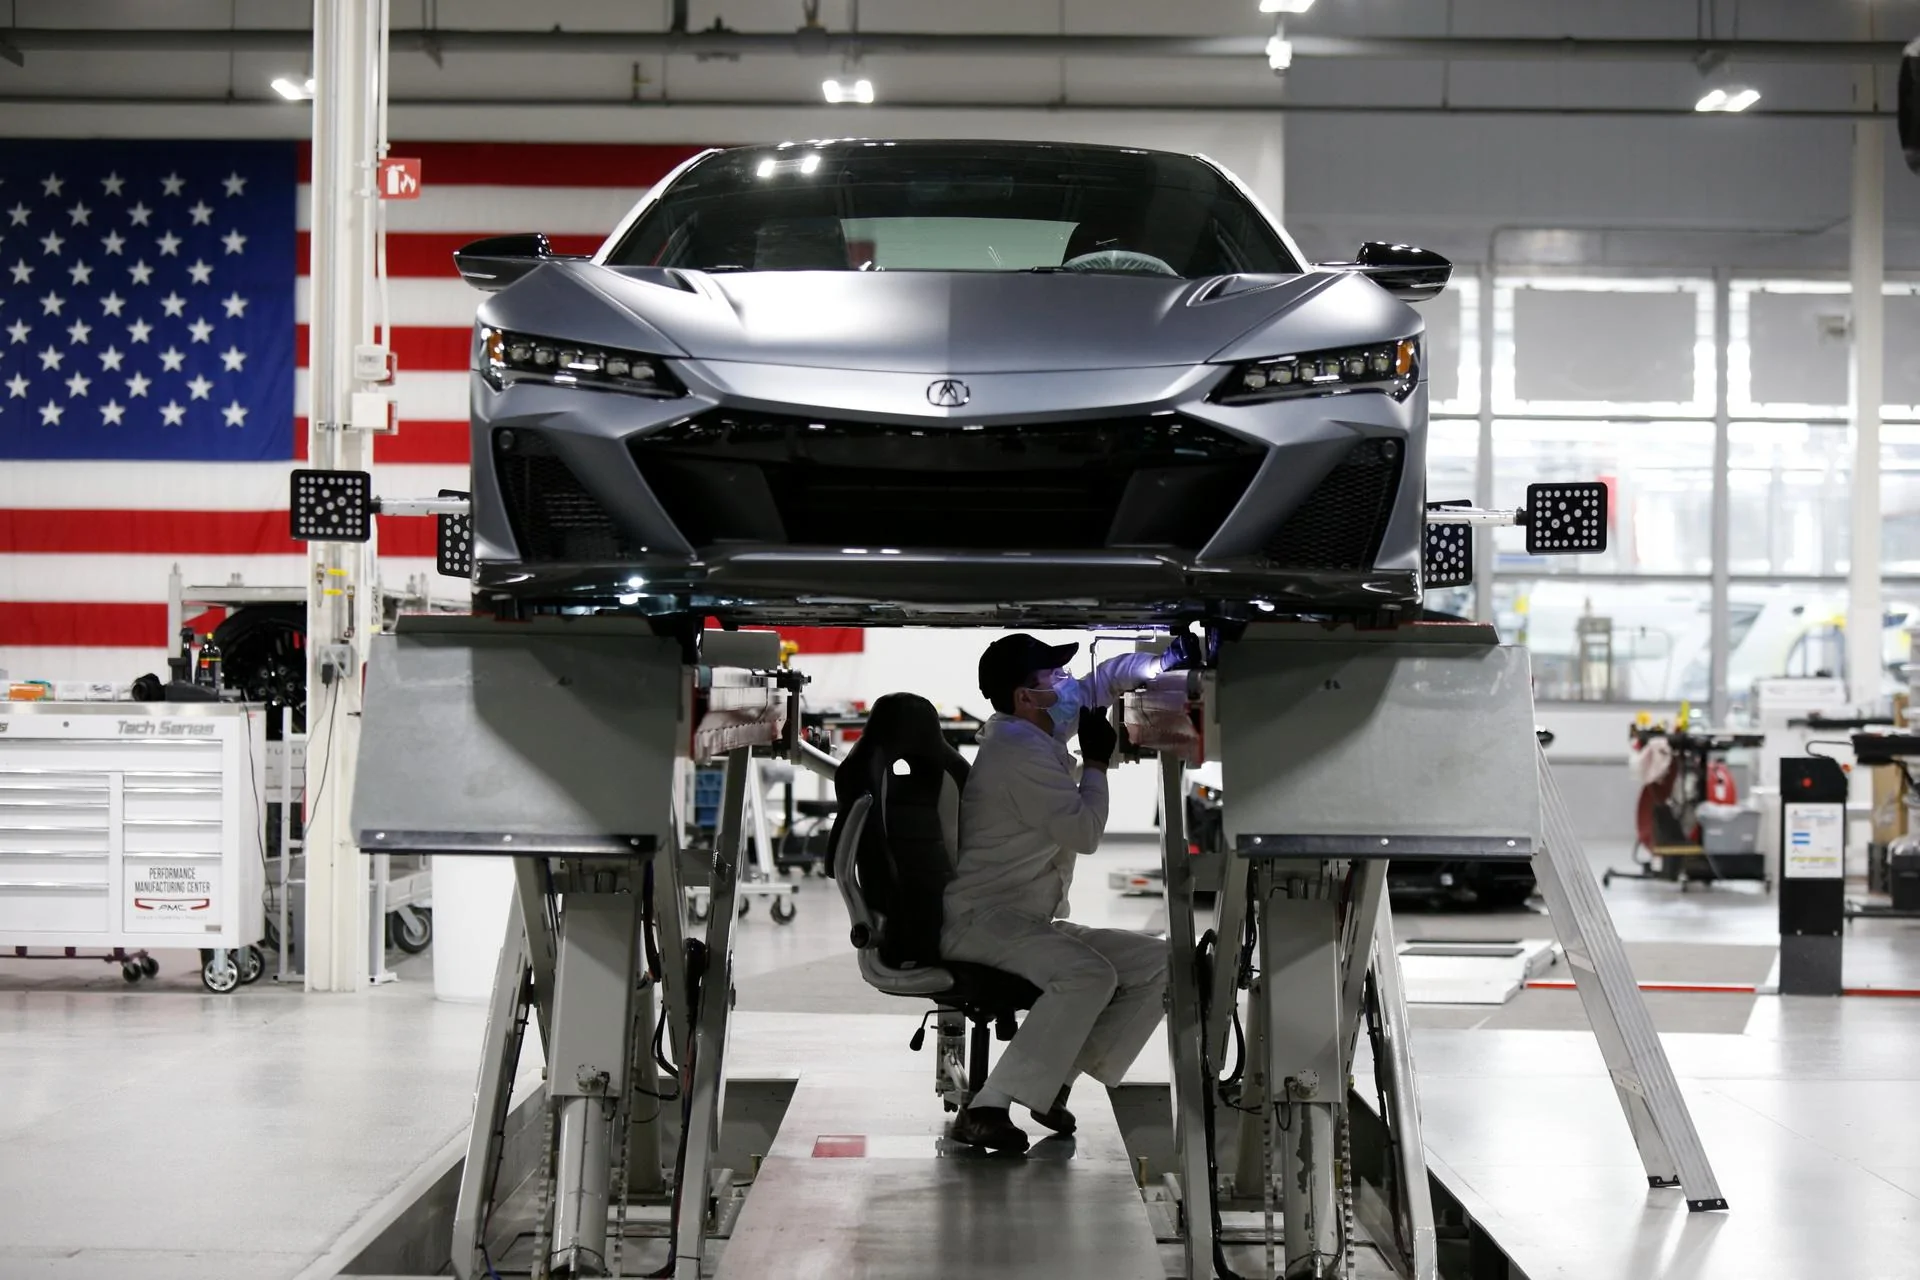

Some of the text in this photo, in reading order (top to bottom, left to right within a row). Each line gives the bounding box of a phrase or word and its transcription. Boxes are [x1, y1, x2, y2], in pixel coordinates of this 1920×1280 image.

[117, 720, 215, 736] Tech Series
[149, 867, 196, 880] PERFORMANCE
[134, 881, 211, 894] MANUFACTURING CENTER
